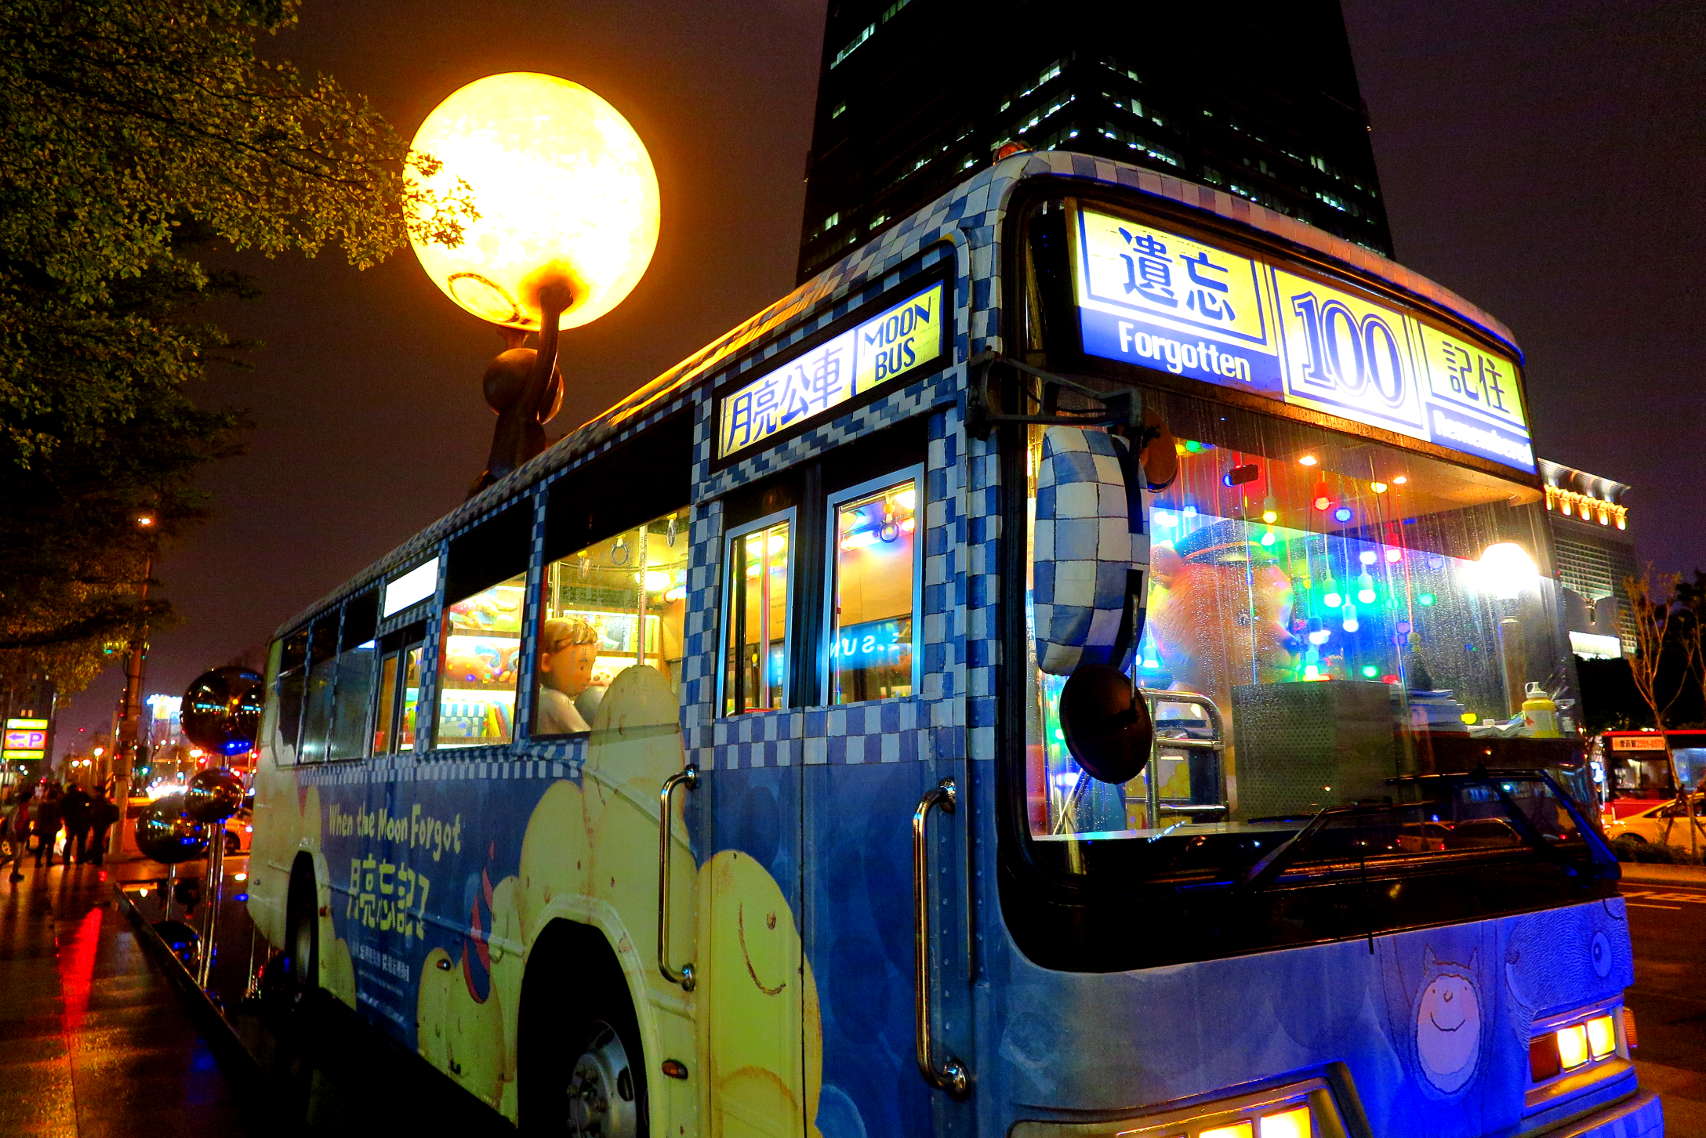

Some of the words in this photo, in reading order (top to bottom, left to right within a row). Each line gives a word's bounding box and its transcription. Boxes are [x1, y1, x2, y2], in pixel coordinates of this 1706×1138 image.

[1118, 226, 1236, 322] 遺忘
[864, 295, 932, 349] MOON
[1117, 320, 1252, 383] Forgotten
[1290, 290, 1406, 407] 100
[874, 337, 916, 382] BUS
[1441, 340, 1512, 415] 記住
[726, 345, 844, 452] 月亮公車
[28, 732, 43, 747] P
[329, 802, 353, 837] When
[356, 800, 376, 838] the
[377, 807, 408, 844] Moon
[410, 803, 461, 862] Forgot
[346, 853, 431, 941] 月亮忘記了
